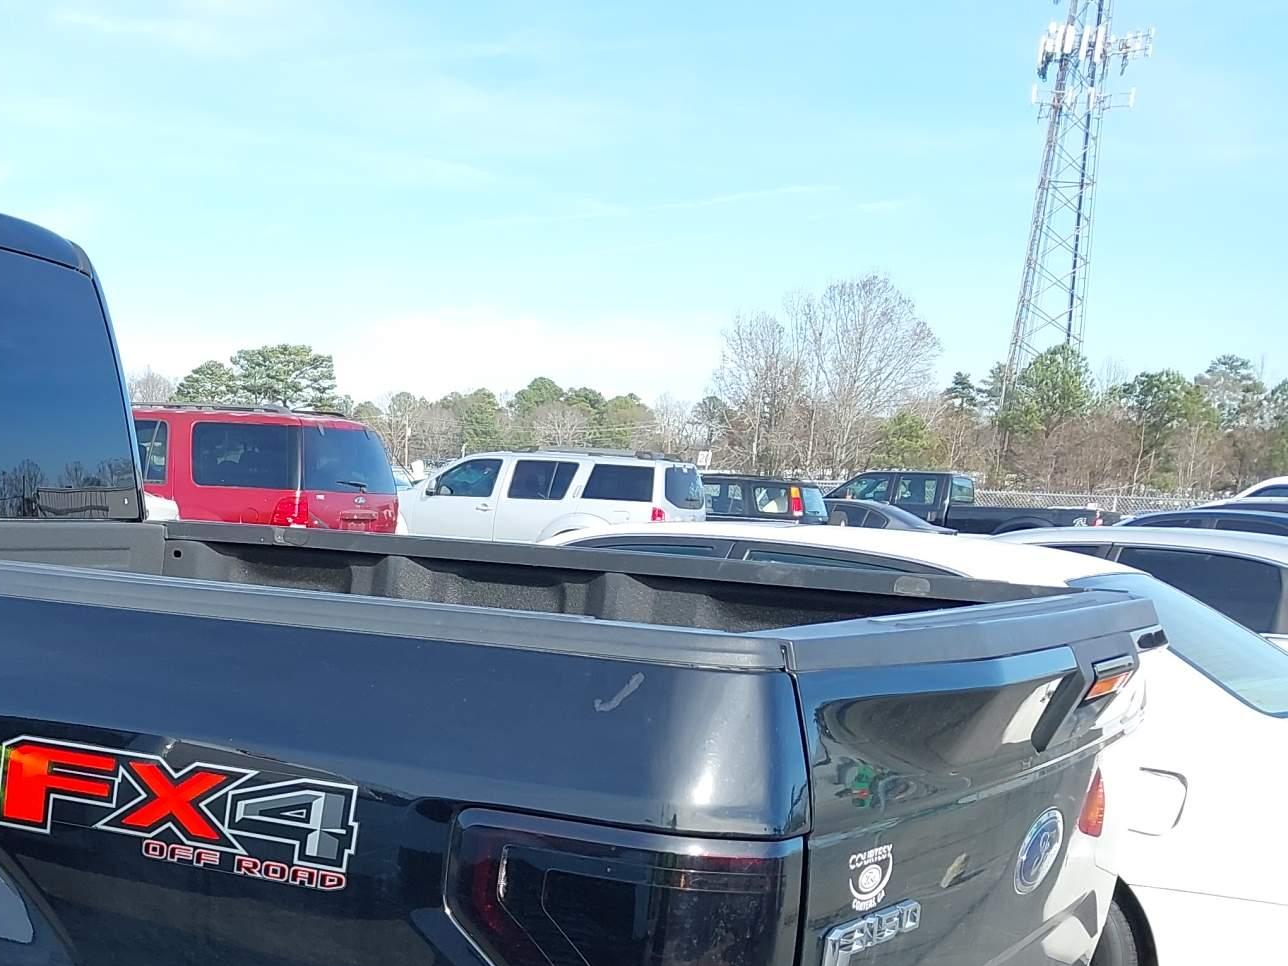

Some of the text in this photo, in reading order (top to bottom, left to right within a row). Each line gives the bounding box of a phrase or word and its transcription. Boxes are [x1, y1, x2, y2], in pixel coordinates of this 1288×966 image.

[141, 838, 347, 892] OFF ROAD
[849, 843, 893, 870] COURTESY
